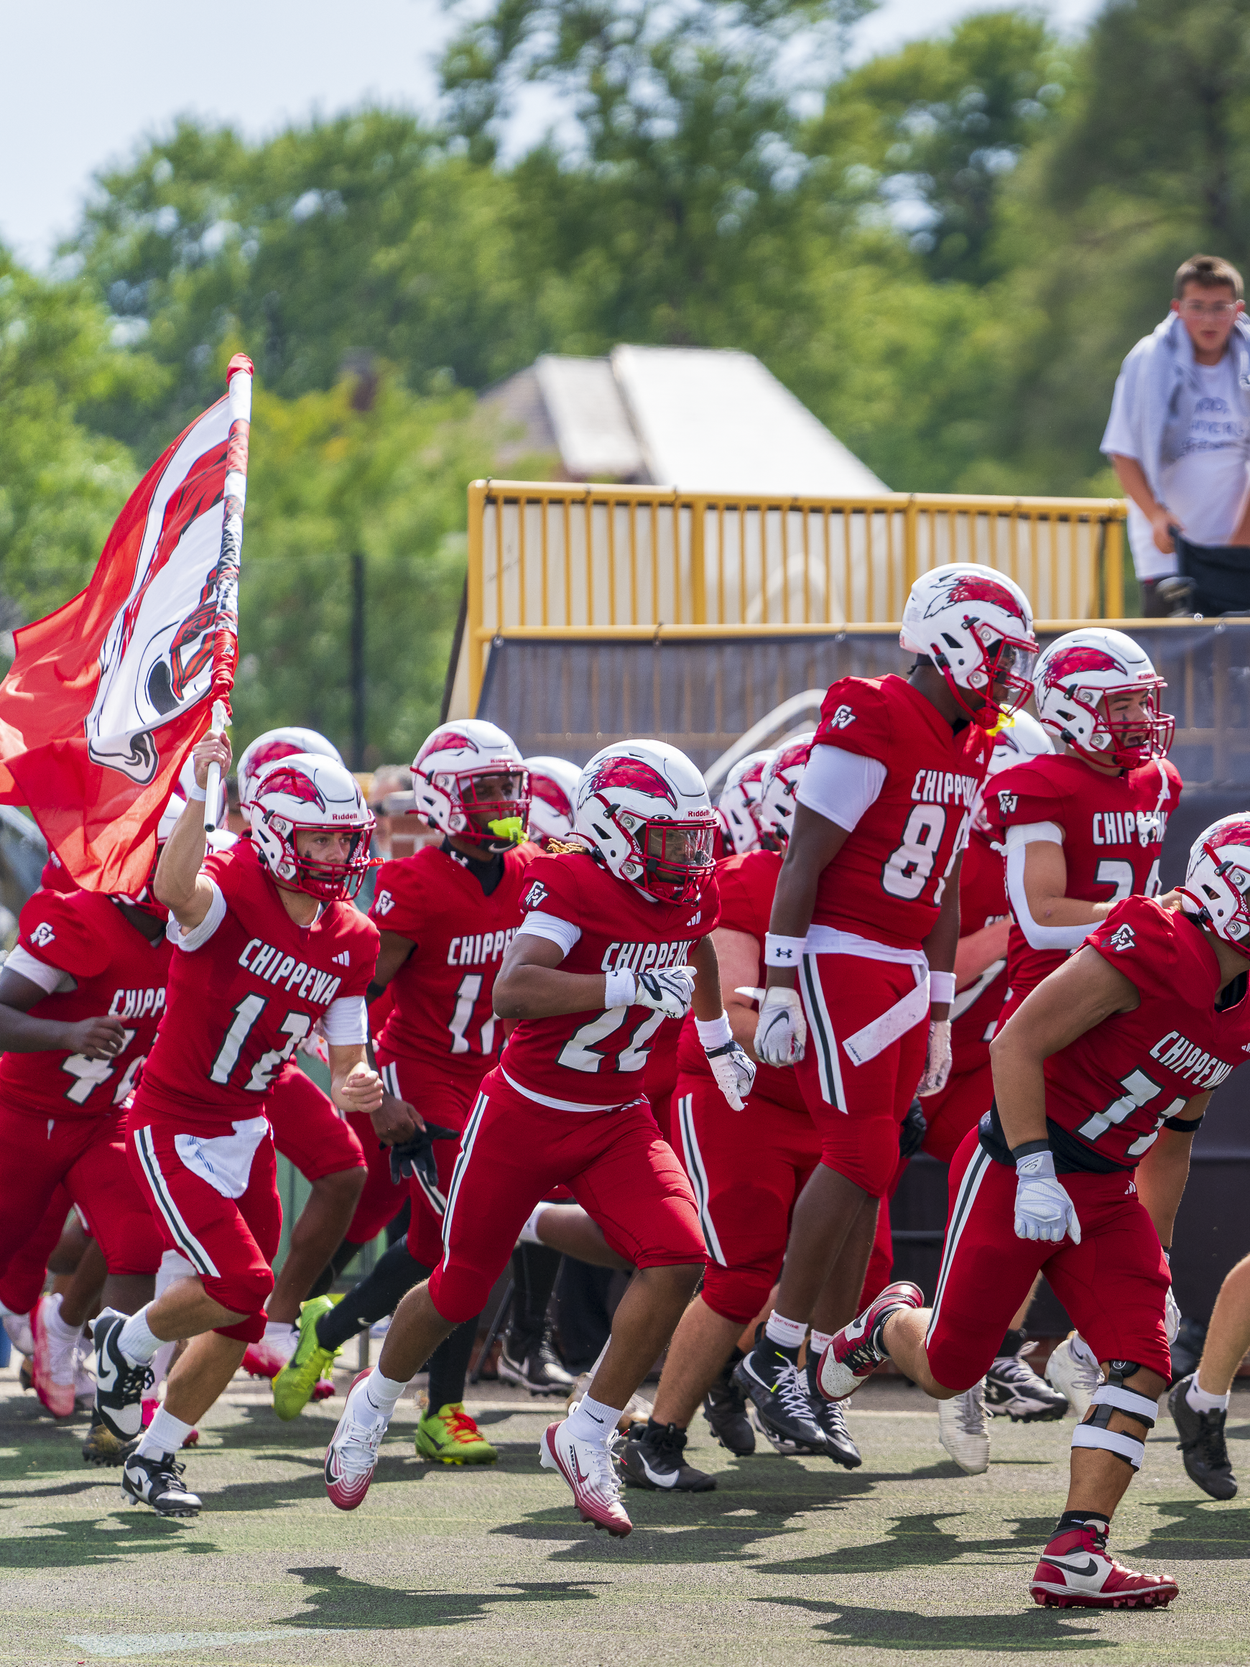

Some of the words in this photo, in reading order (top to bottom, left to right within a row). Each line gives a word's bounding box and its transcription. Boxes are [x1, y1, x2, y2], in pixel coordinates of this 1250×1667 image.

[108, 986, 168, 1019] CHIPP
[237, 937, 333, 1006] CHIPPEWA
[206, 990, 311, 1092] 12
